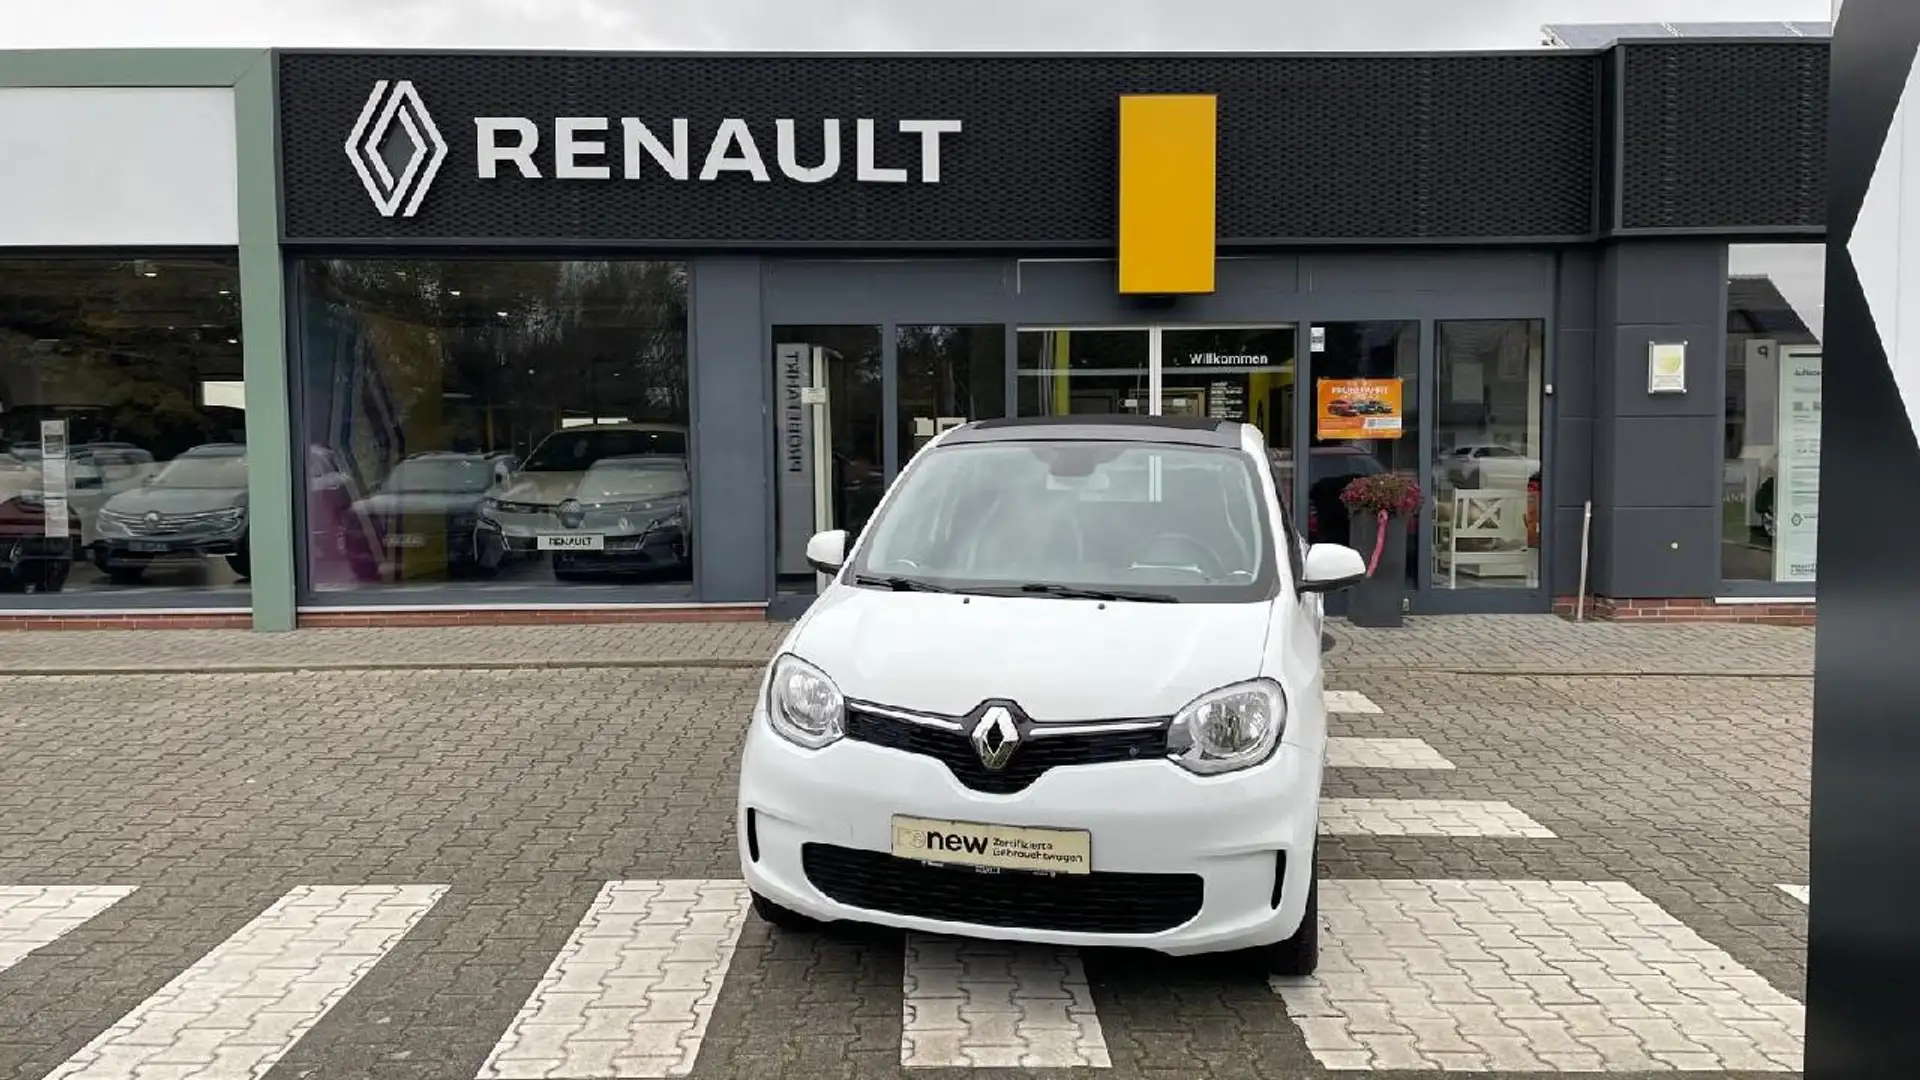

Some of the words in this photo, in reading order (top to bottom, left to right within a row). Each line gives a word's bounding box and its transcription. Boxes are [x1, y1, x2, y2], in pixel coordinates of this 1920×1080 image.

[474, 117, 962, 183] RENAULT
[1189, 352, 1268, 364] Willkommen
[549, 537, 592, 546] RENAULT
